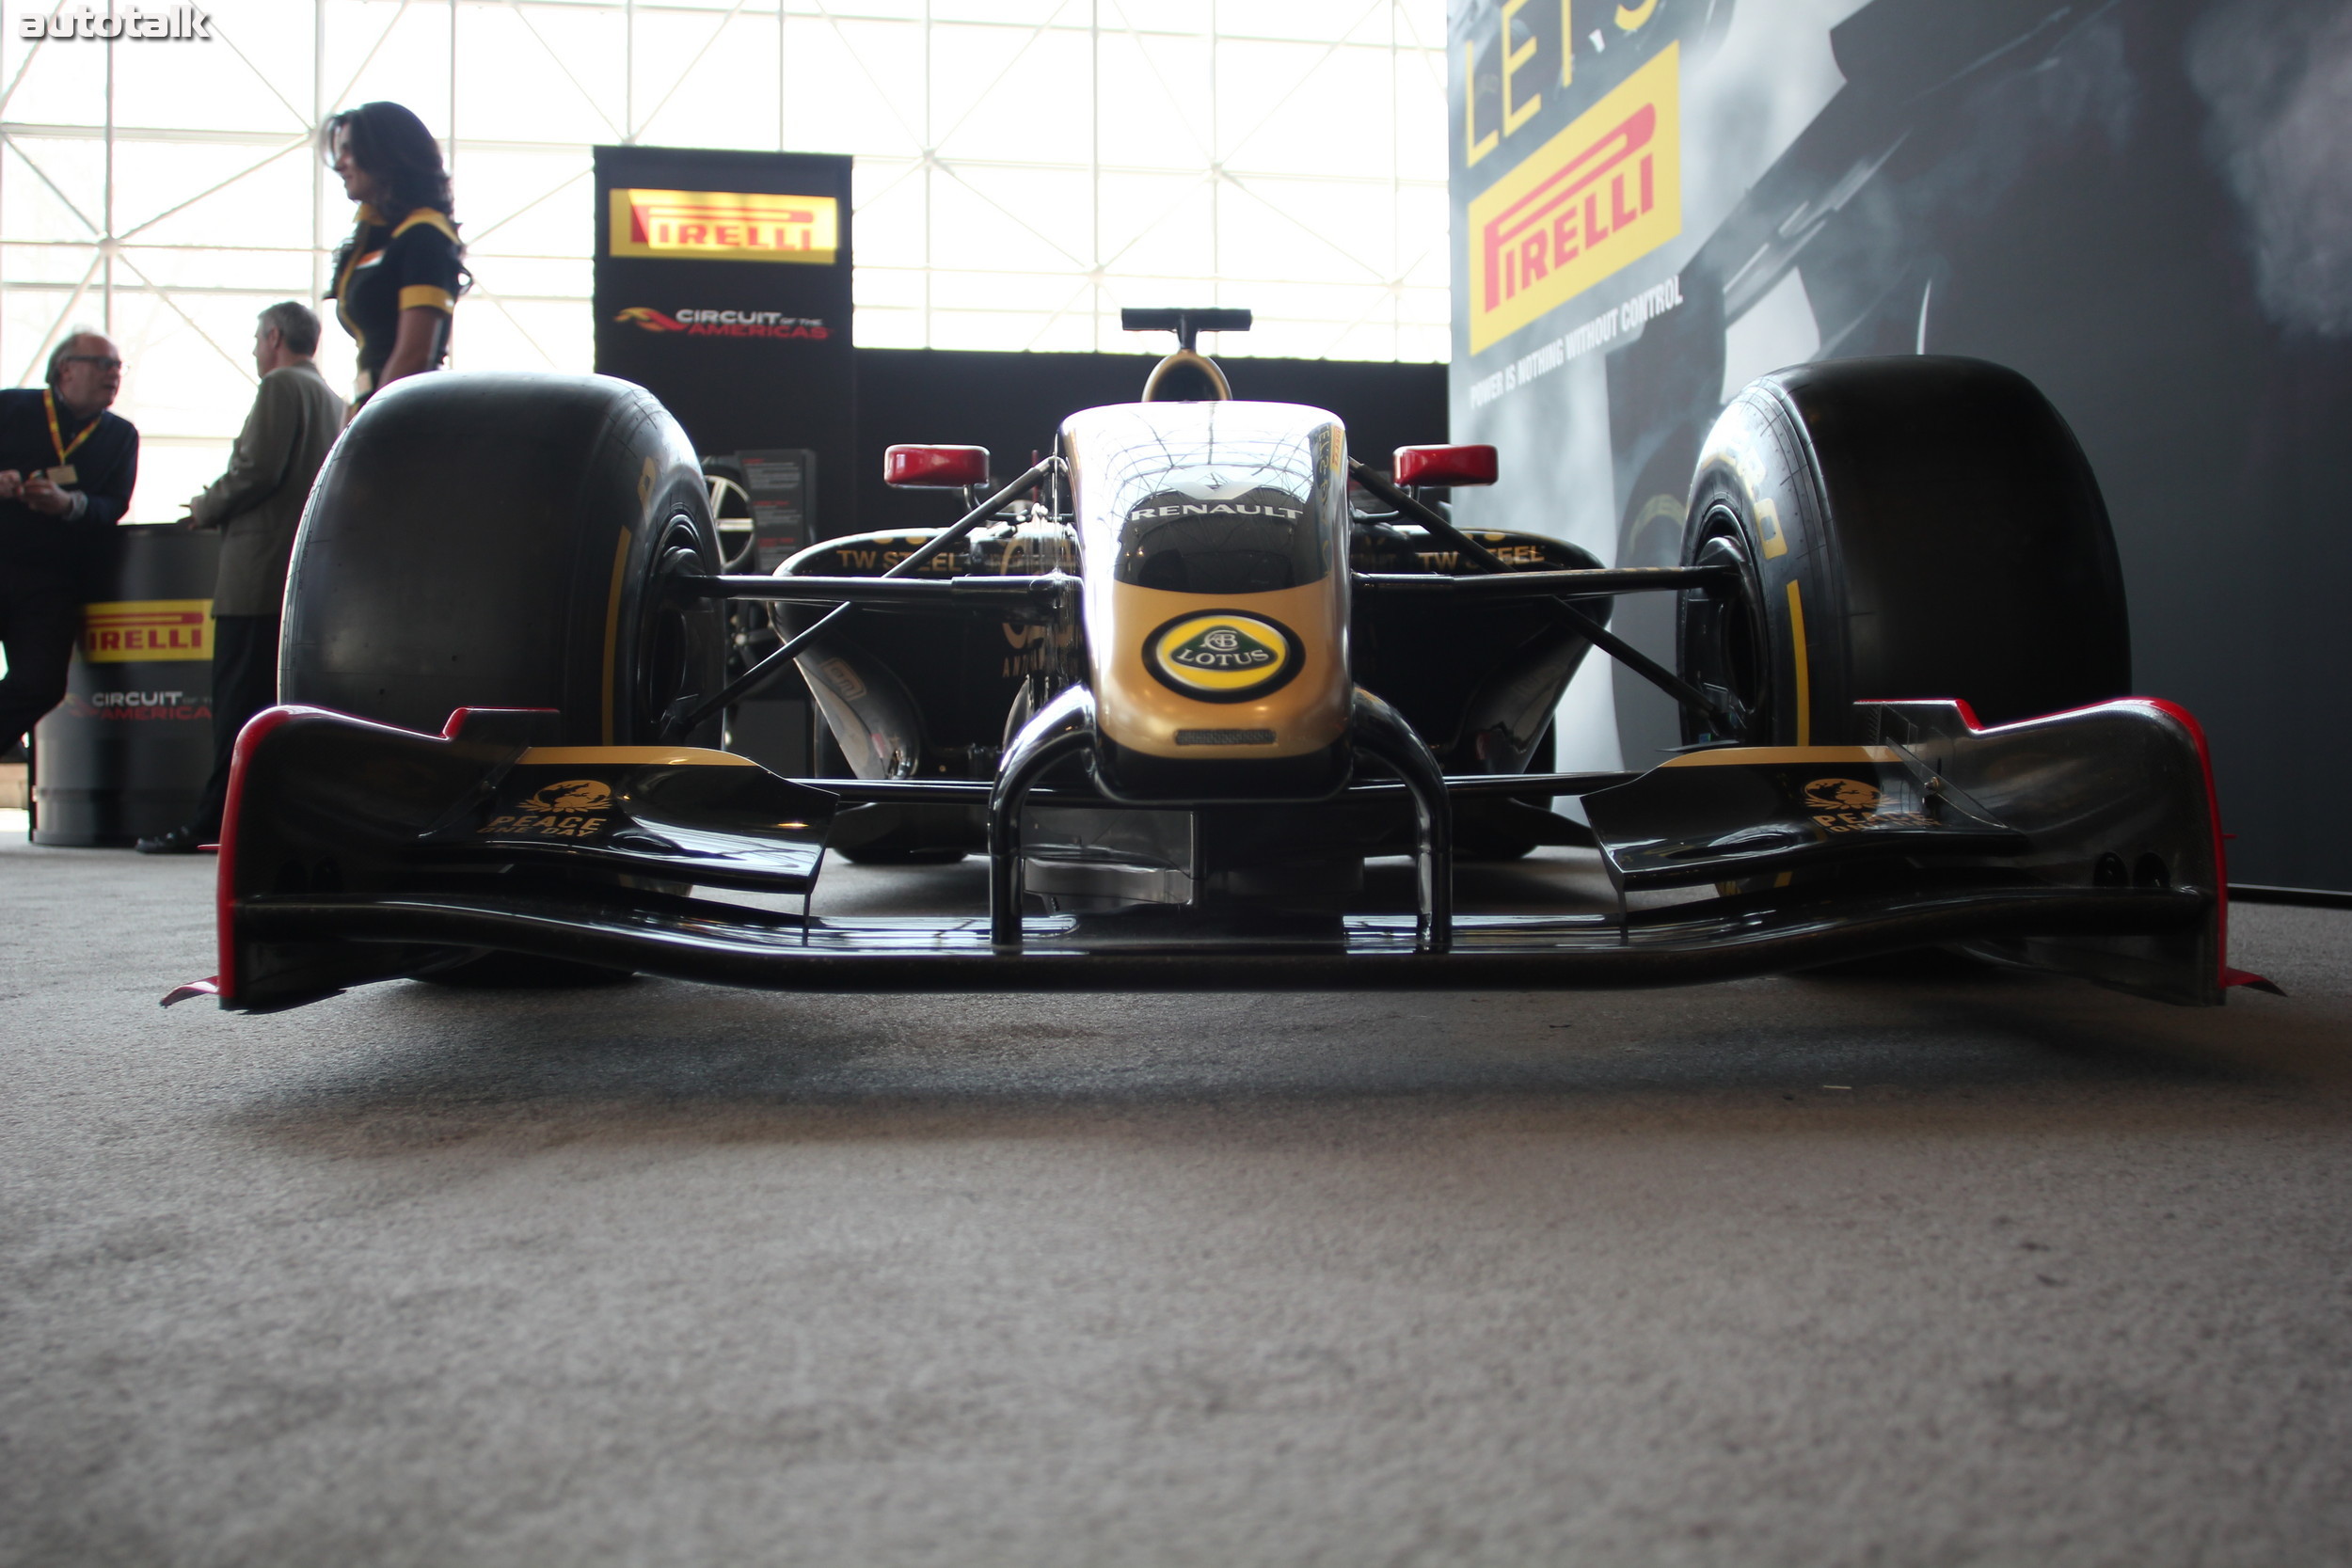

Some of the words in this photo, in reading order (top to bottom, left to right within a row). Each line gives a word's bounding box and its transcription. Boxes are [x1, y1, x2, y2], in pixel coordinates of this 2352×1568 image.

[1466, 0, 1659, 168] LET
[1483, 102, 1657, 315] PIRELLI
[630, 204, 814, 250] PIRELLI
[675, 308, 782, 325] CIRCUIT
[687, 323, 829, 340] AMERICAS
[1470, 361, 1503, 410] POWER
[1504, 357, 1517, 391] IS
[1518, 336, 1565, 388] NOTHING
[1565, 307, 1618, 362] WITHOUT
[1620, 274, 1684, 333] CONTROL
[1131, 502, 1304, 521] RENAULT
[835, 549, 877, 568] TW
[883, 551, 961, 572] SEL
[1417, 551, 1460, 570] TW
[1177, 649, 1269, 666] LOTUS
[91, 691, 183, 706] CIRCUIT
[98, 705, 212, 721] AMERICA
[488, 816, 607, 831] PEACE
[1812, 810, 1934, 828] PEACE
[477, 826, 531, 834] ONE
[540, 827, 595, 837] DAY
